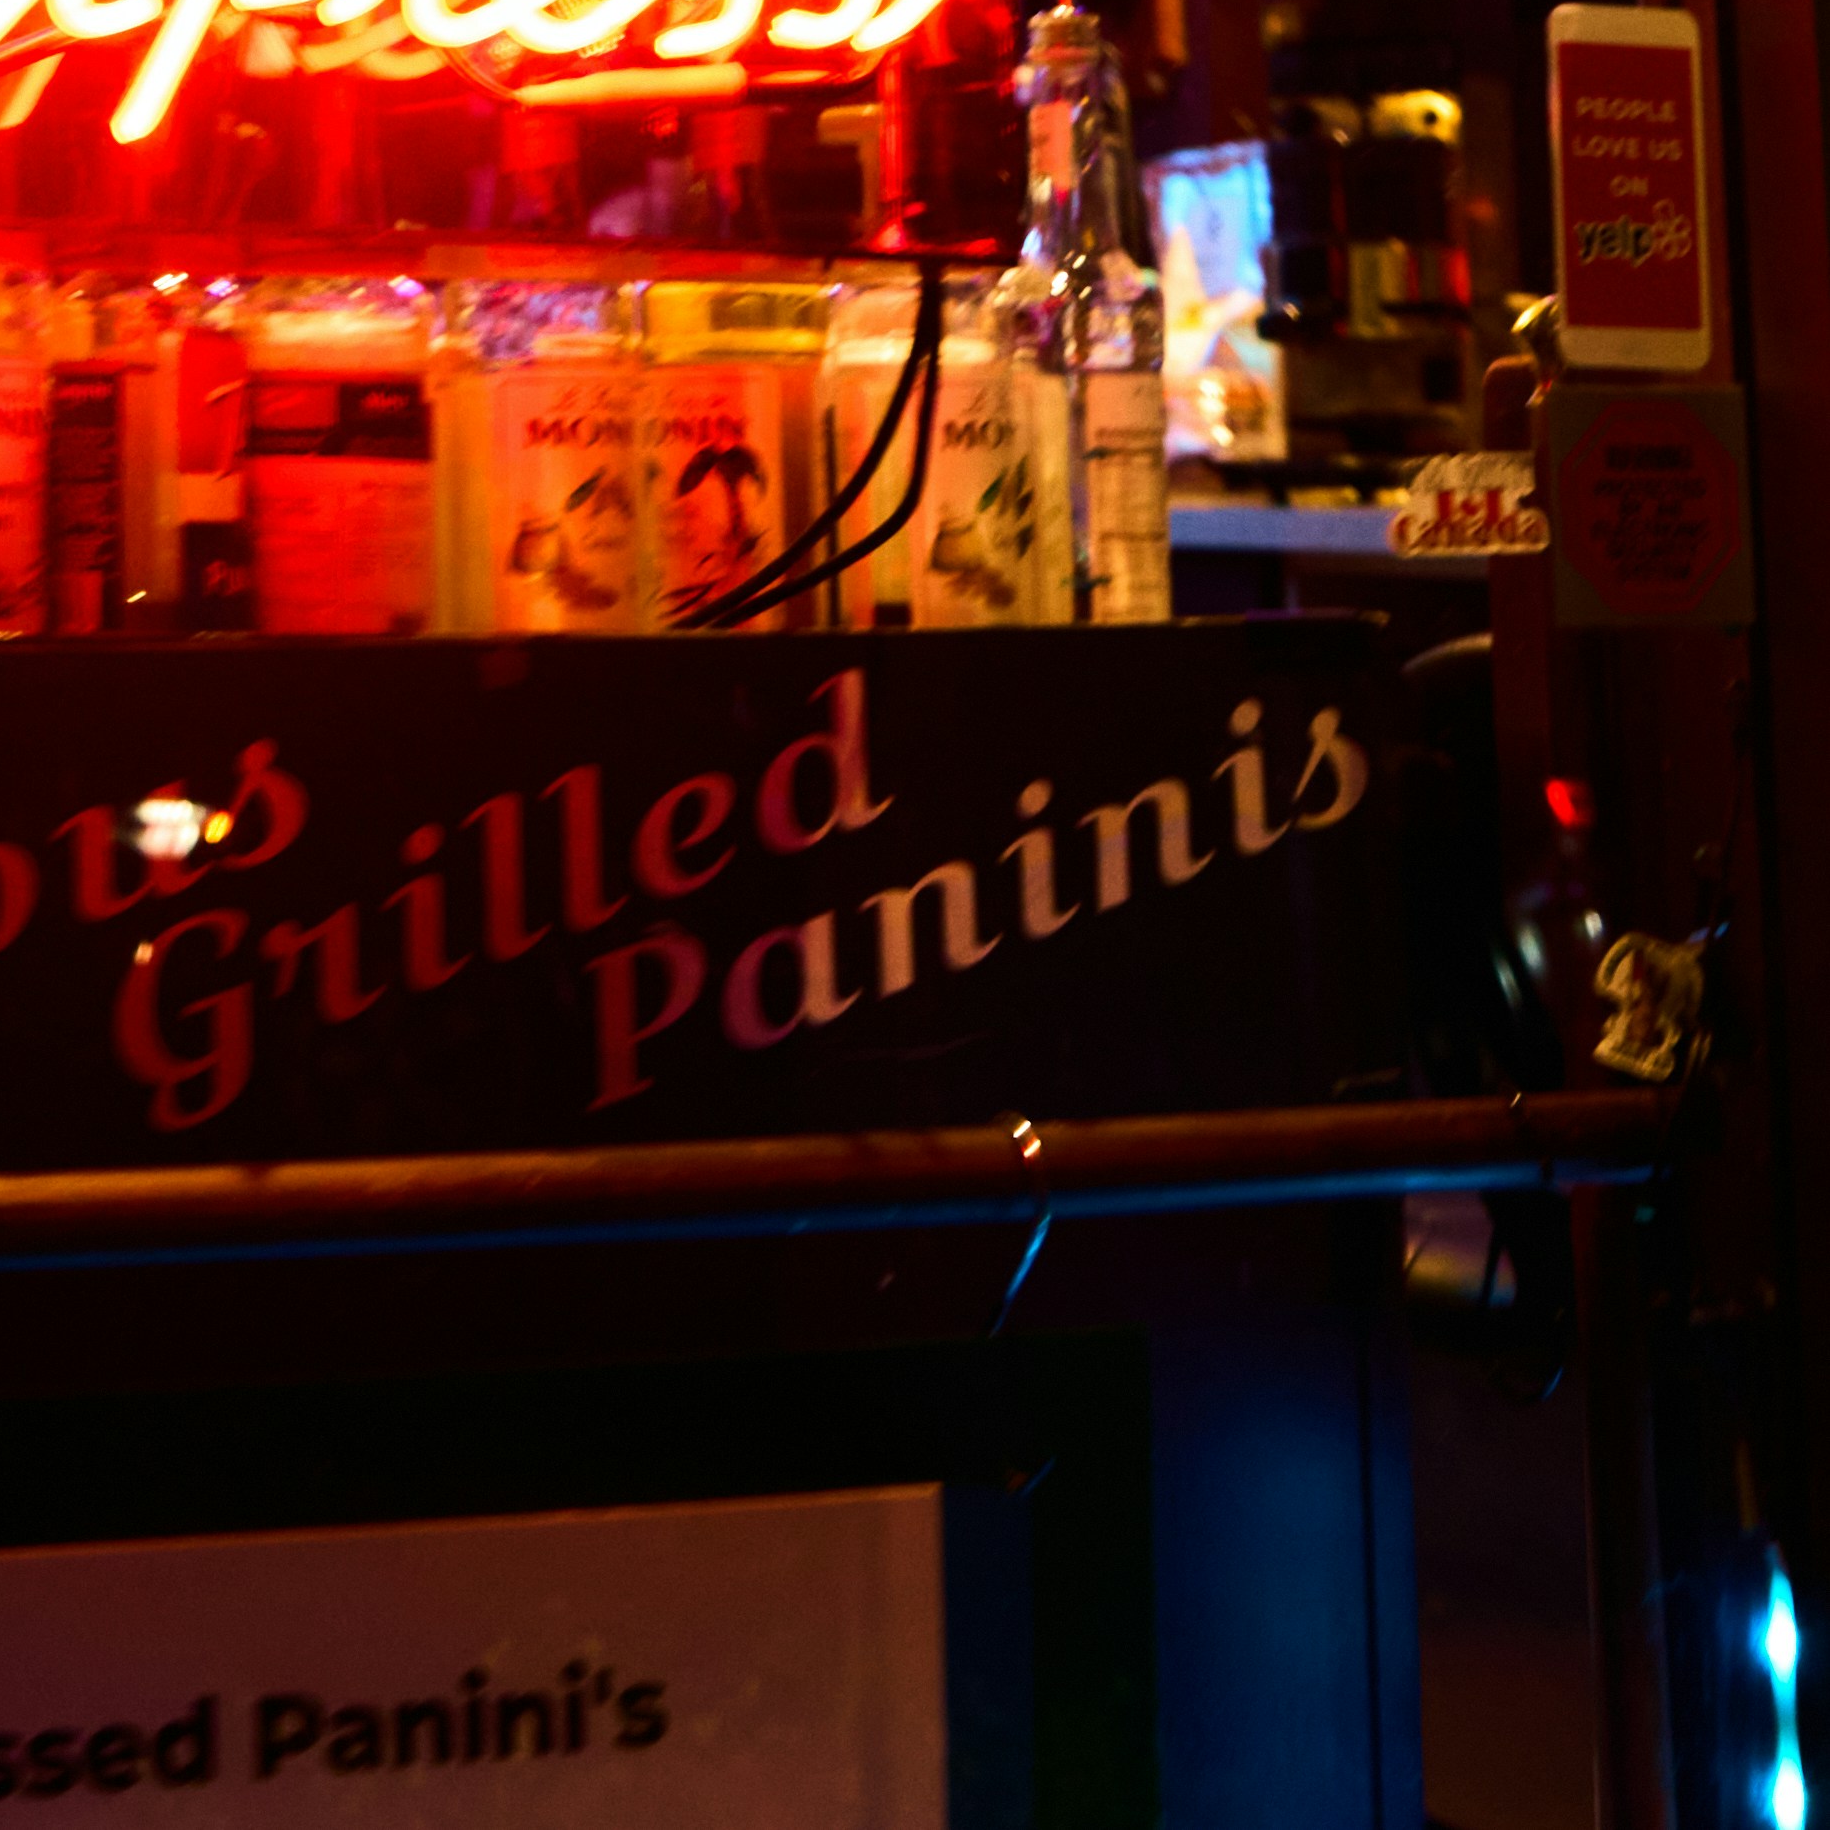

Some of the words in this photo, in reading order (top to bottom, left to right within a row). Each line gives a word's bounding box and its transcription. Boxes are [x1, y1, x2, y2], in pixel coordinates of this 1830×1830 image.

[1574, 96, 1678, 124] PEOPLE
[1572, 134, 1641, 161] LOVE
[1647, 136, 1684, 163] US
[1609, 174, 1650, 198] ON
[1573, 213, 1653, 267] yelp
[112, 666, 893, 1130] Grilled
[584, 696, 1368, 1112] Paninis
[251, 1658, 669, 1783] Panini's
